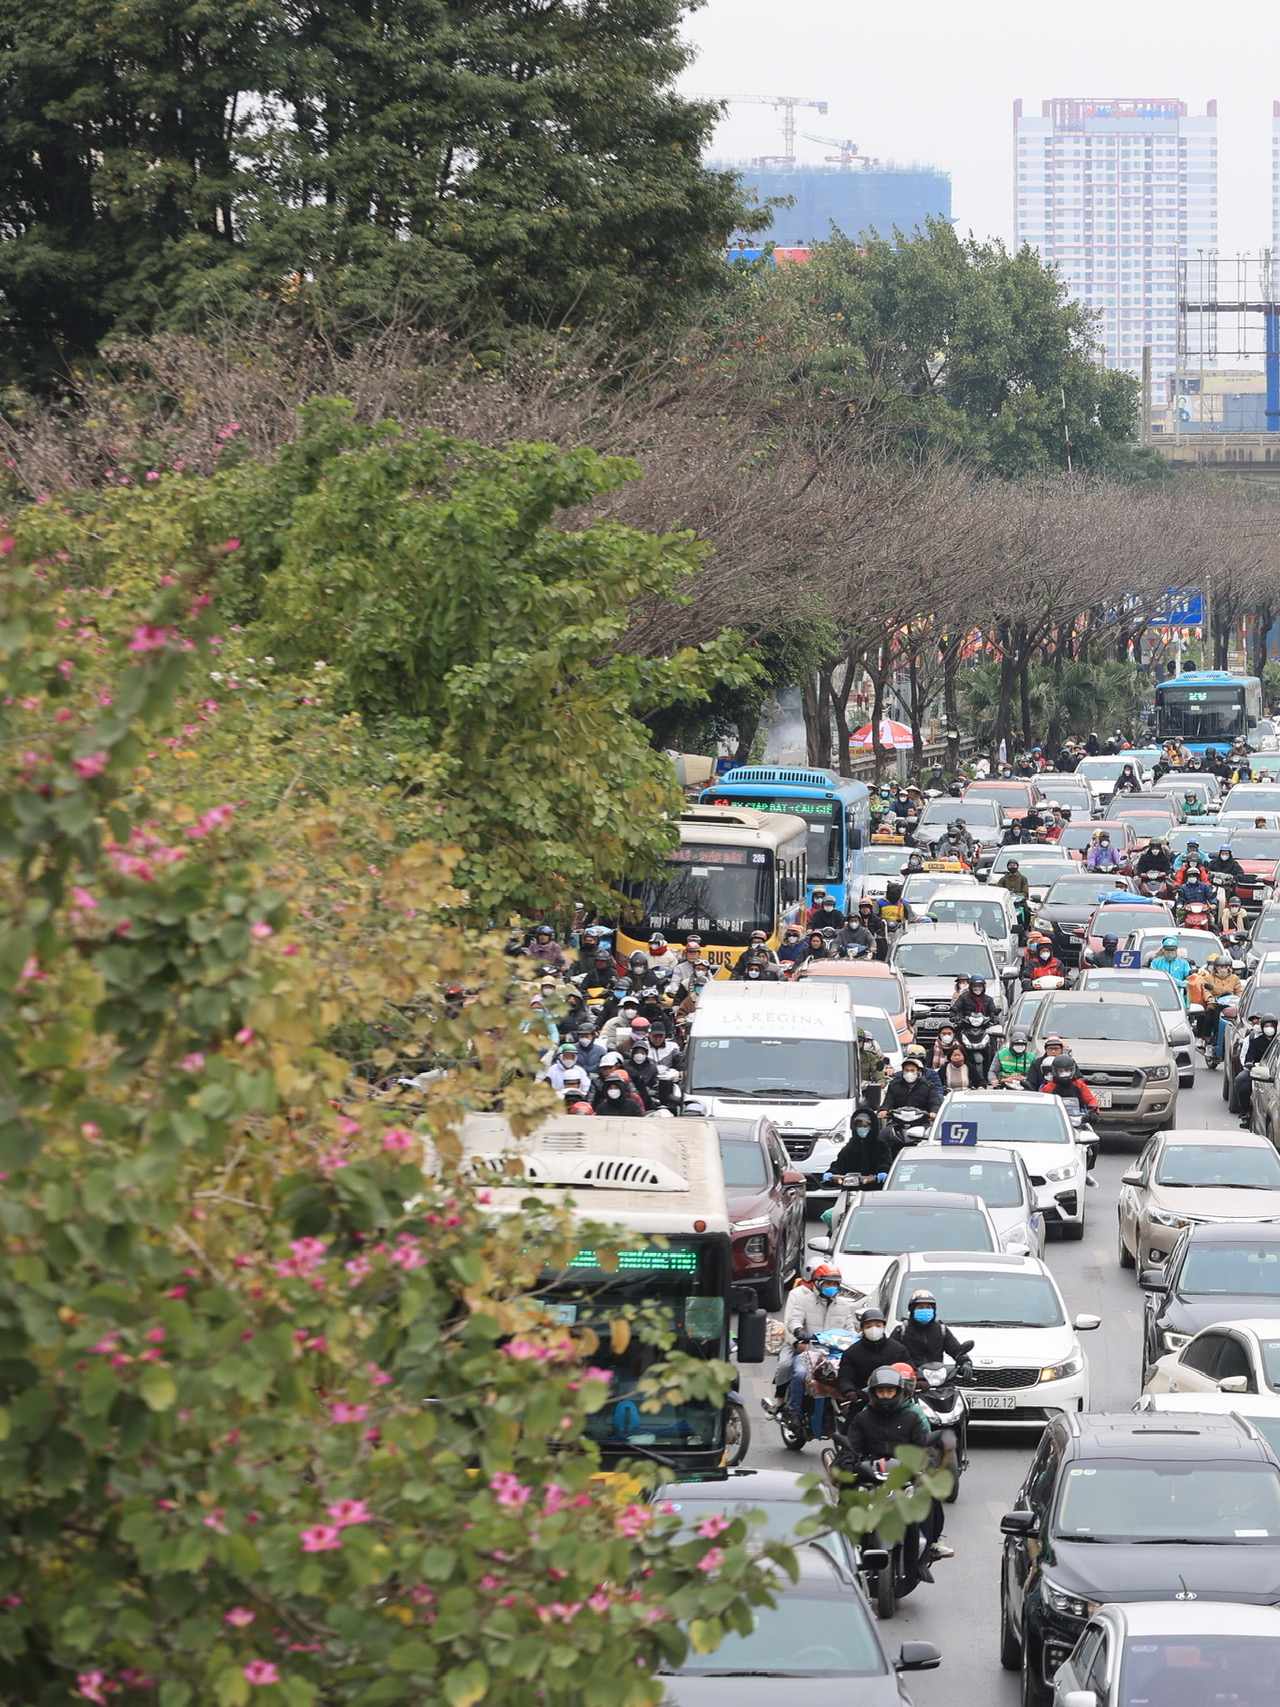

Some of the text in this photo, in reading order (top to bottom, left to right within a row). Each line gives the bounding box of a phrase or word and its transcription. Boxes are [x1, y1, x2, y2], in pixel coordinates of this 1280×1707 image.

[708, 951, 731, 965] BUS
[1120, 952, 1134, 966] G7
[723, 1013, 823, 1026] LA REGINA
[950, 1124, 969, 1143] G7
